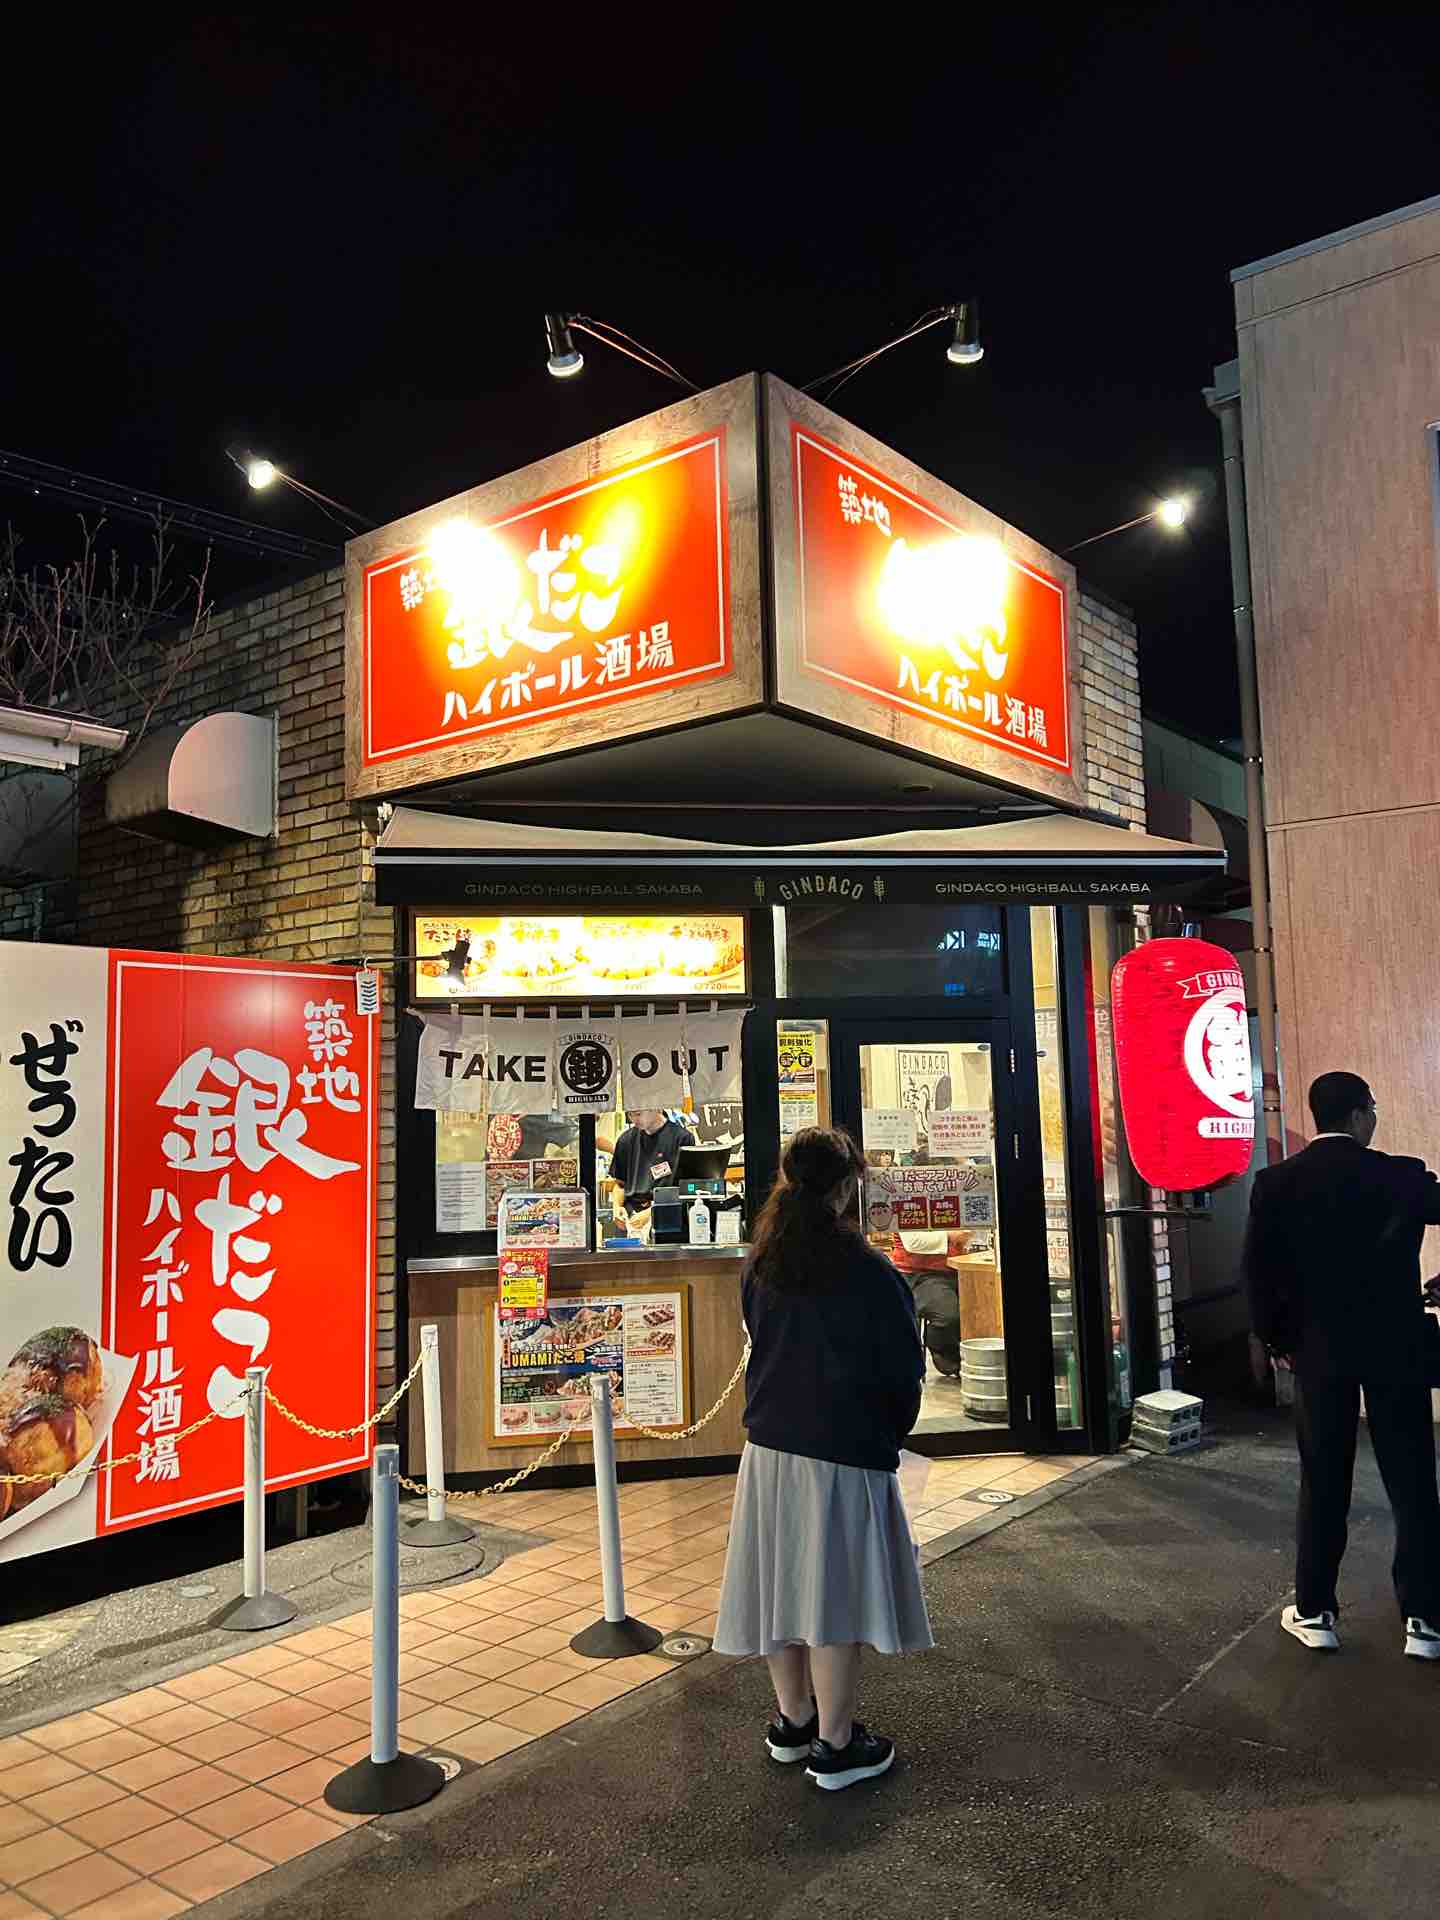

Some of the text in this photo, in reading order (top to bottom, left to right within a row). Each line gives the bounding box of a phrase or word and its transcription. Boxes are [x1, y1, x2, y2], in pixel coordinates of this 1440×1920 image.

[838, 473, 891, 536] 築地
[440, 621, 674, 727] ハイボール酒場
[897, 654, 1048, 748] ハイボール酒場
[464, 884, 704, 896] GINDACO HIGHBALL SAKABA
[779, 874, 865, 900] GINDACO
[935, 882, 1151, 894] GINDACO HIGHBALL SAKABA
[296, 999, 361, 1112] 築地
[438, 1045, 729, 1082] TAKE OUT
[902, 1055, 946, 1070] GINDACO
[8, 1018, 84, 1272] ぜったい
[156, 1046, 361, 1420] 銀だこ
[136, 1188, 190, 1484] ハイボール酒場
